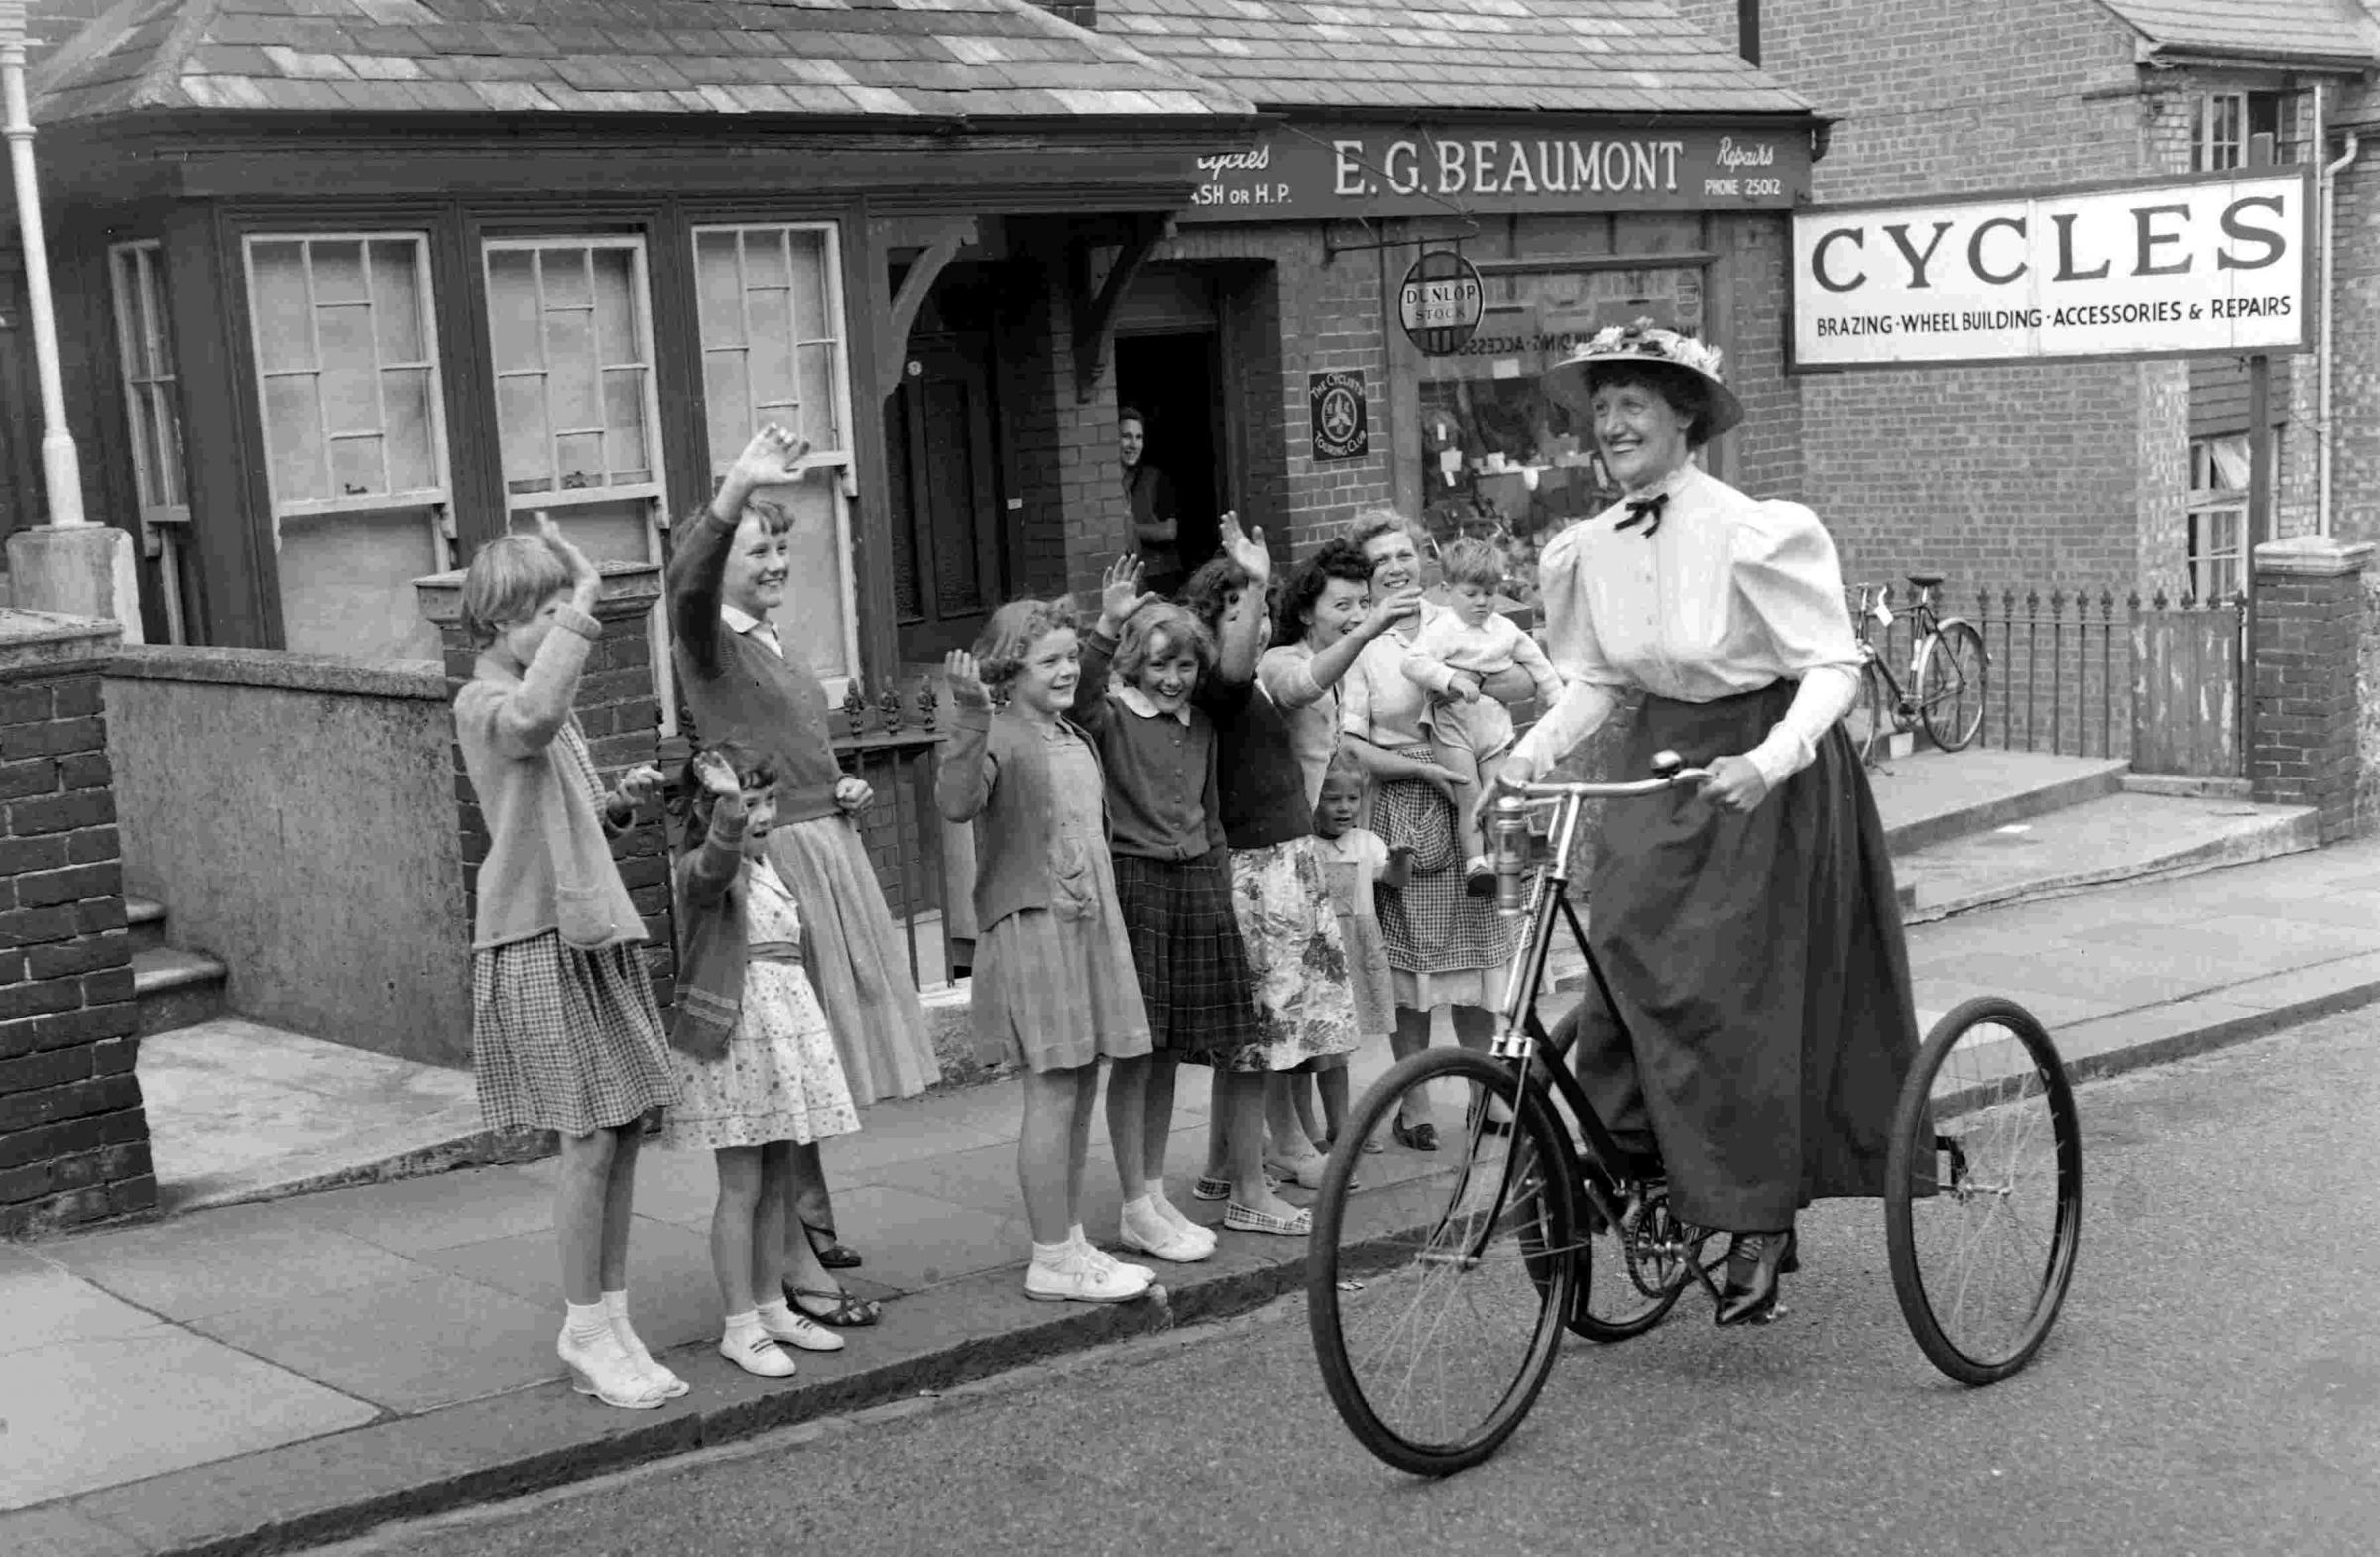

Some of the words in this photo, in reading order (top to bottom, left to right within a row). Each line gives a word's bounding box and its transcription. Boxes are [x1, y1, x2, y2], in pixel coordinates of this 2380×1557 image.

[1435, 140, 1684, 193] BEAUMONT
[1716, 136, 1774, 174] Repairs
[1255, 183, 1293, 204] H.P.
[1704, 178, 1739, 196] PHONE
[1744, 177, 1781, 196] 25012
[1810, 195, 2288, 293] CYCLES
[1406, 284, 1476, 305] DUNLOP
[1415, 306, 1466, 321] STOCK
[1816, 315, 1893, 337] BRAZING
[1901, 312, 1960, 334] WHEEL
[1962, 308, 2043, 332] BUILDING
[2052, 300, 2183, 328] ACCESSORIES
[2188, 303, 2204, 320] &
[2211, 295, 2292, 320] REPAIRS
[1310, 380, 1328, 399] THE
[1314, 430, 1348, 456] TOURING
[1346, 429, 1367, 453] CLUB
